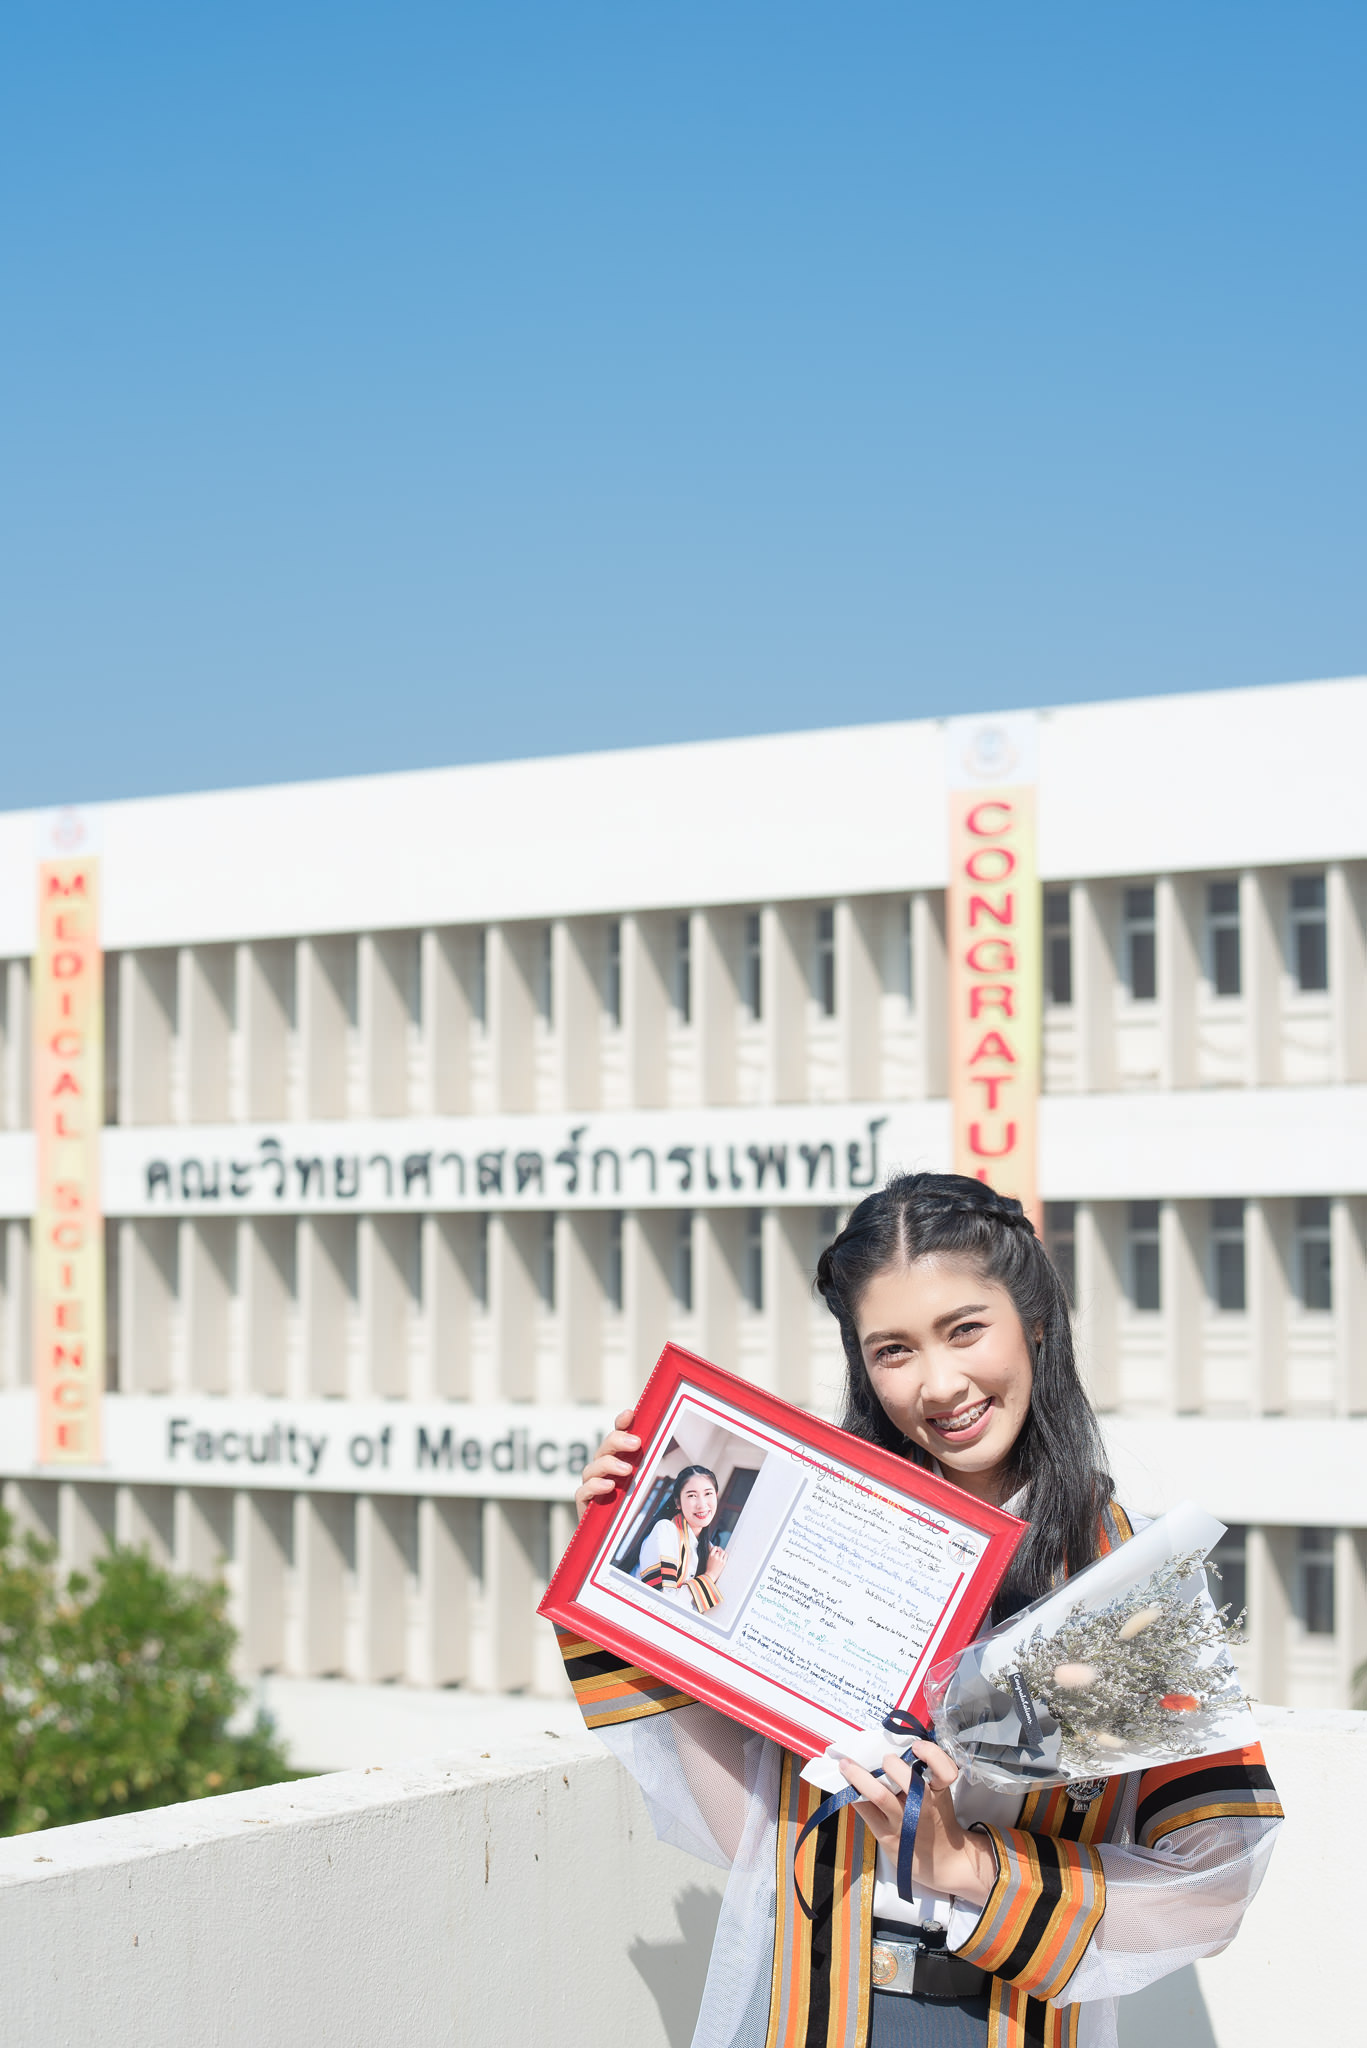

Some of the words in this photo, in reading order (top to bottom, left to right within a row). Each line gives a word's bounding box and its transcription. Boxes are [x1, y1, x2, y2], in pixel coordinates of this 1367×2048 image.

[48, 874, 87, 1138] MEDICAL
[146, 1117, 889, 1198] คณะวิทยาศาสตร์การแพทย์
[50, 1180, 85, 1451] SCIENCE
[166, 1418, 327, 1474] Faculty
[349, 1424, 393, 1468] of
[789, 1444, 904, 1513] Congratulations
[906, 1509, 944, 1534] 2018
